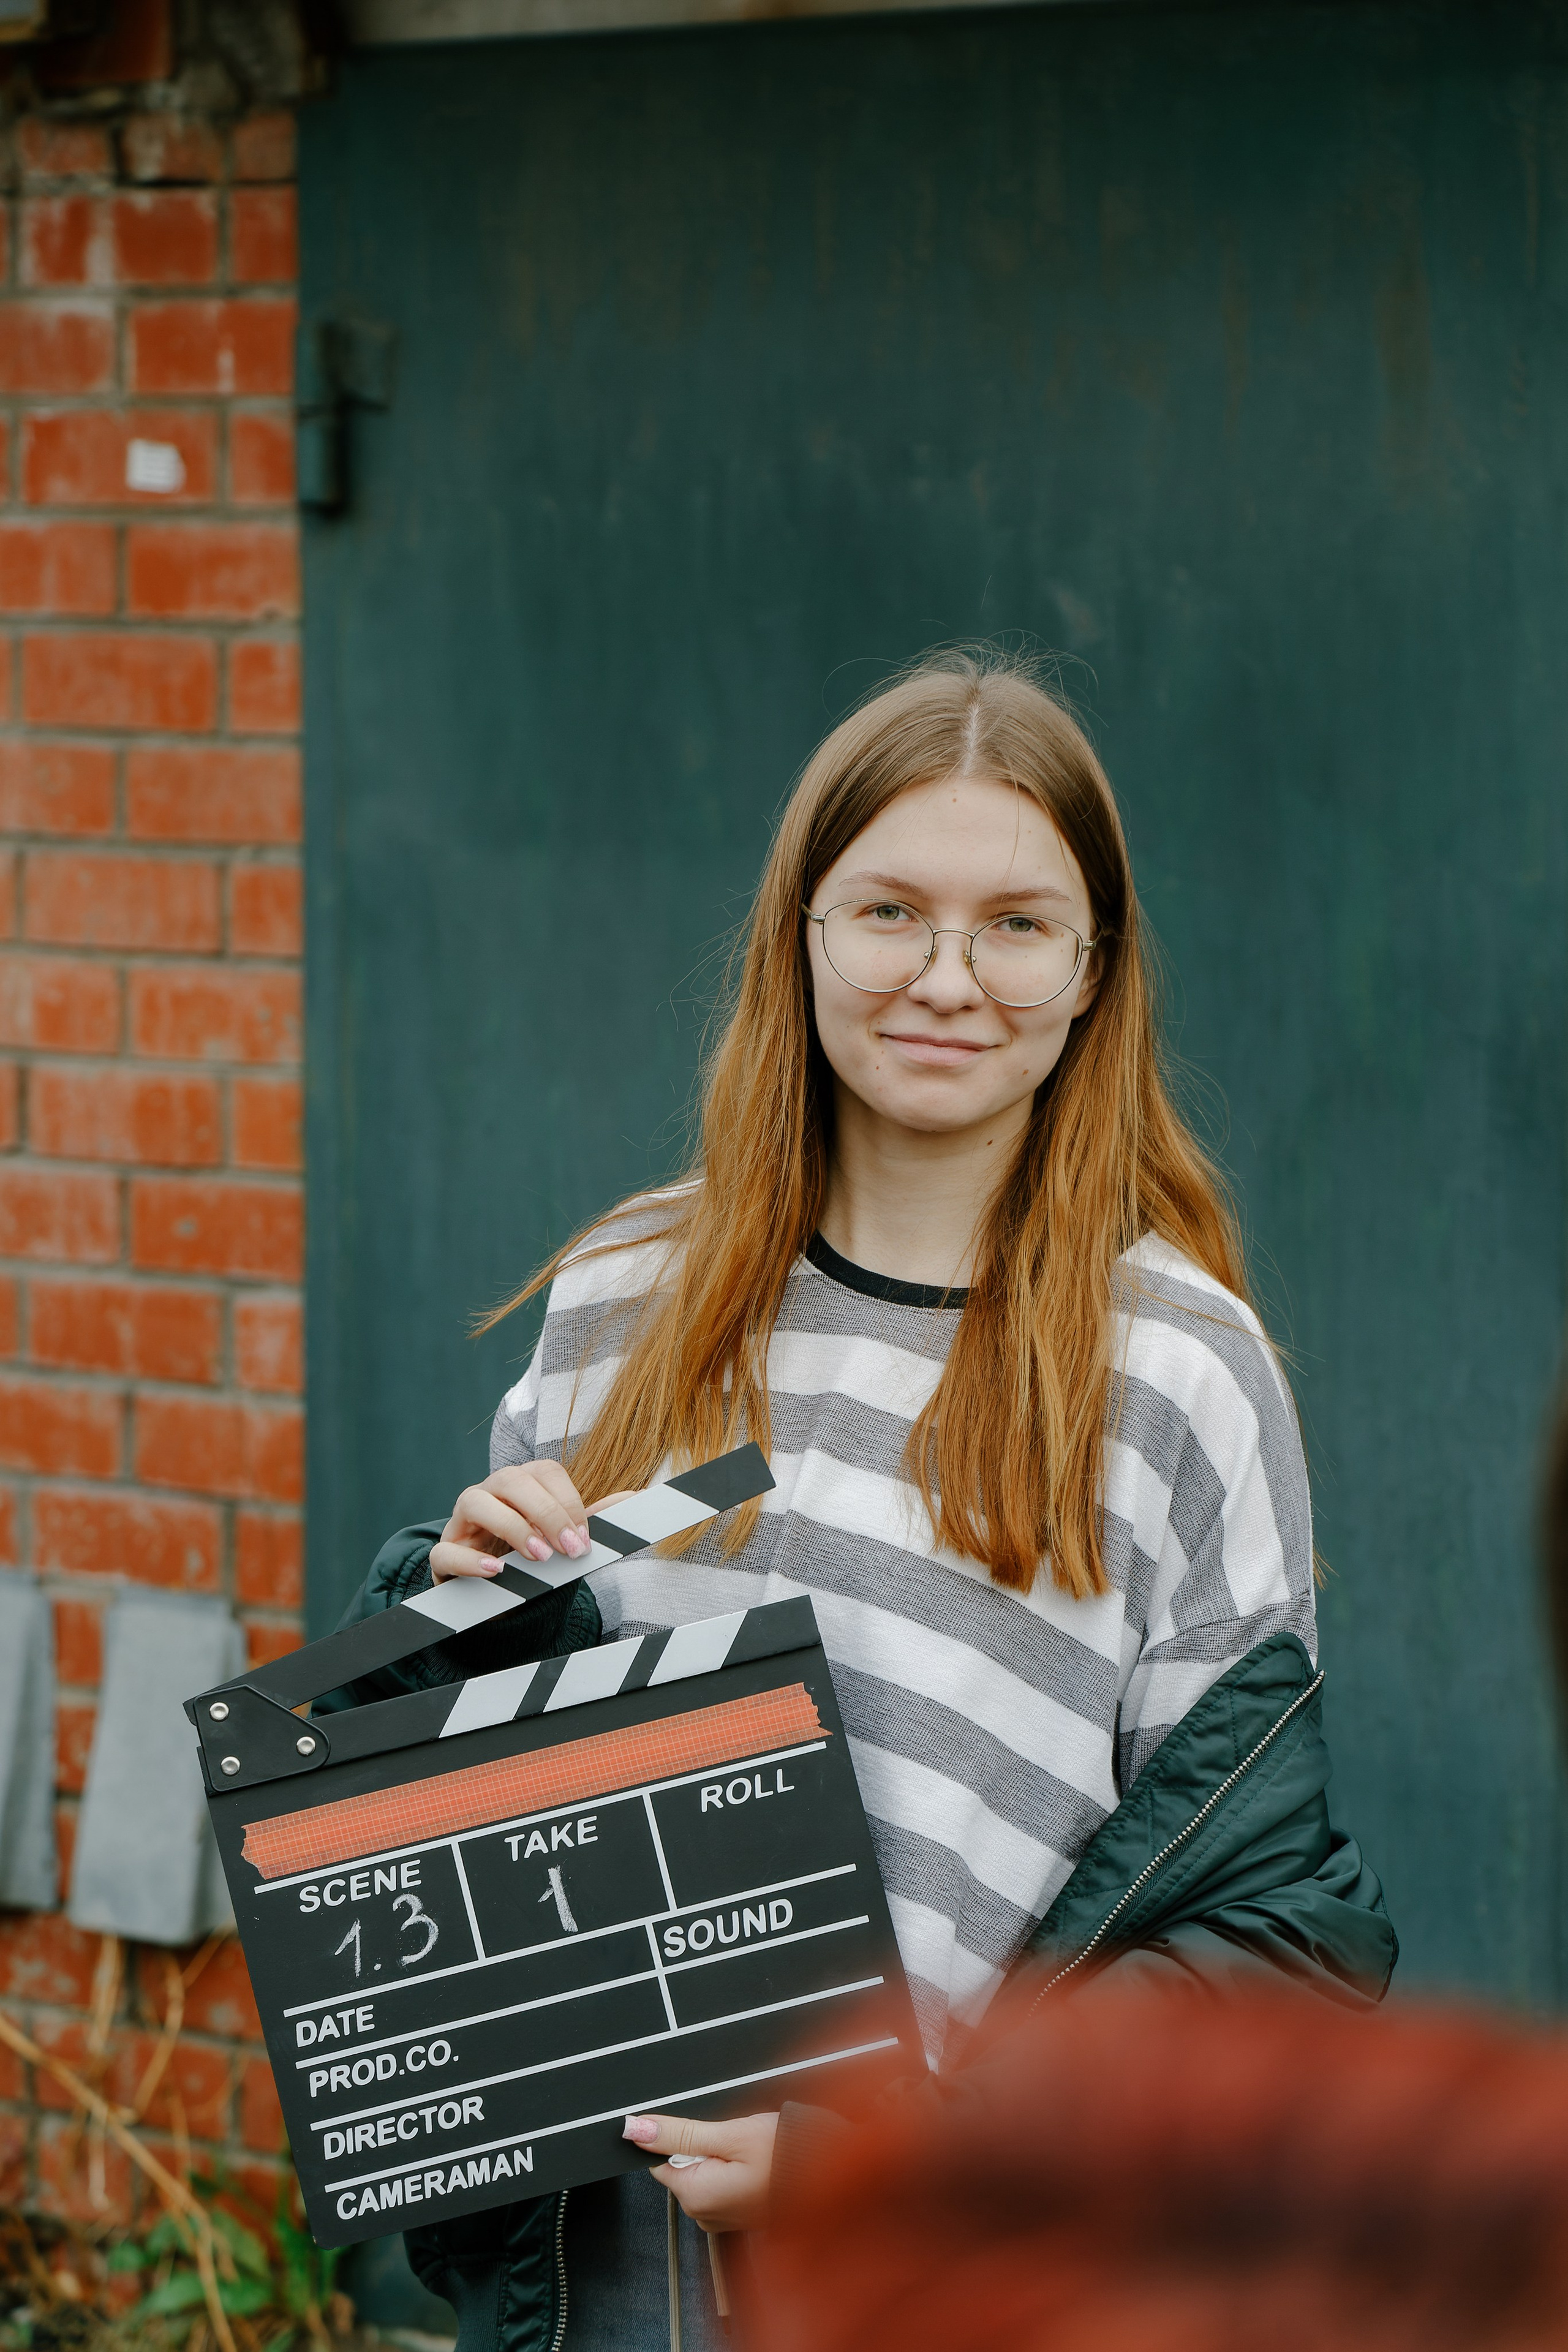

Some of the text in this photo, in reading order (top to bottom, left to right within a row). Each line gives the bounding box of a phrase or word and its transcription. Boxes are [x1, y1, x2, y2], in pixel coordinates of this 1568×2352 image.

[701, 1768, 795, 1813] ROLL
[503, 1815, 598, 1861] TAKE
[299, 1859, 422, 1913] SCENE
[537, 1864, 579, 1932] 1
[663, 1898, 793, 1958] SOUND
[295, 2004, 375, 2048] DATE
[309, 2040, 459, 2098] PROD.CO.
[323, 2095, 485, 2160] DIRECTOR
[336, 2146, 533, 2220] CAMERAMAN
